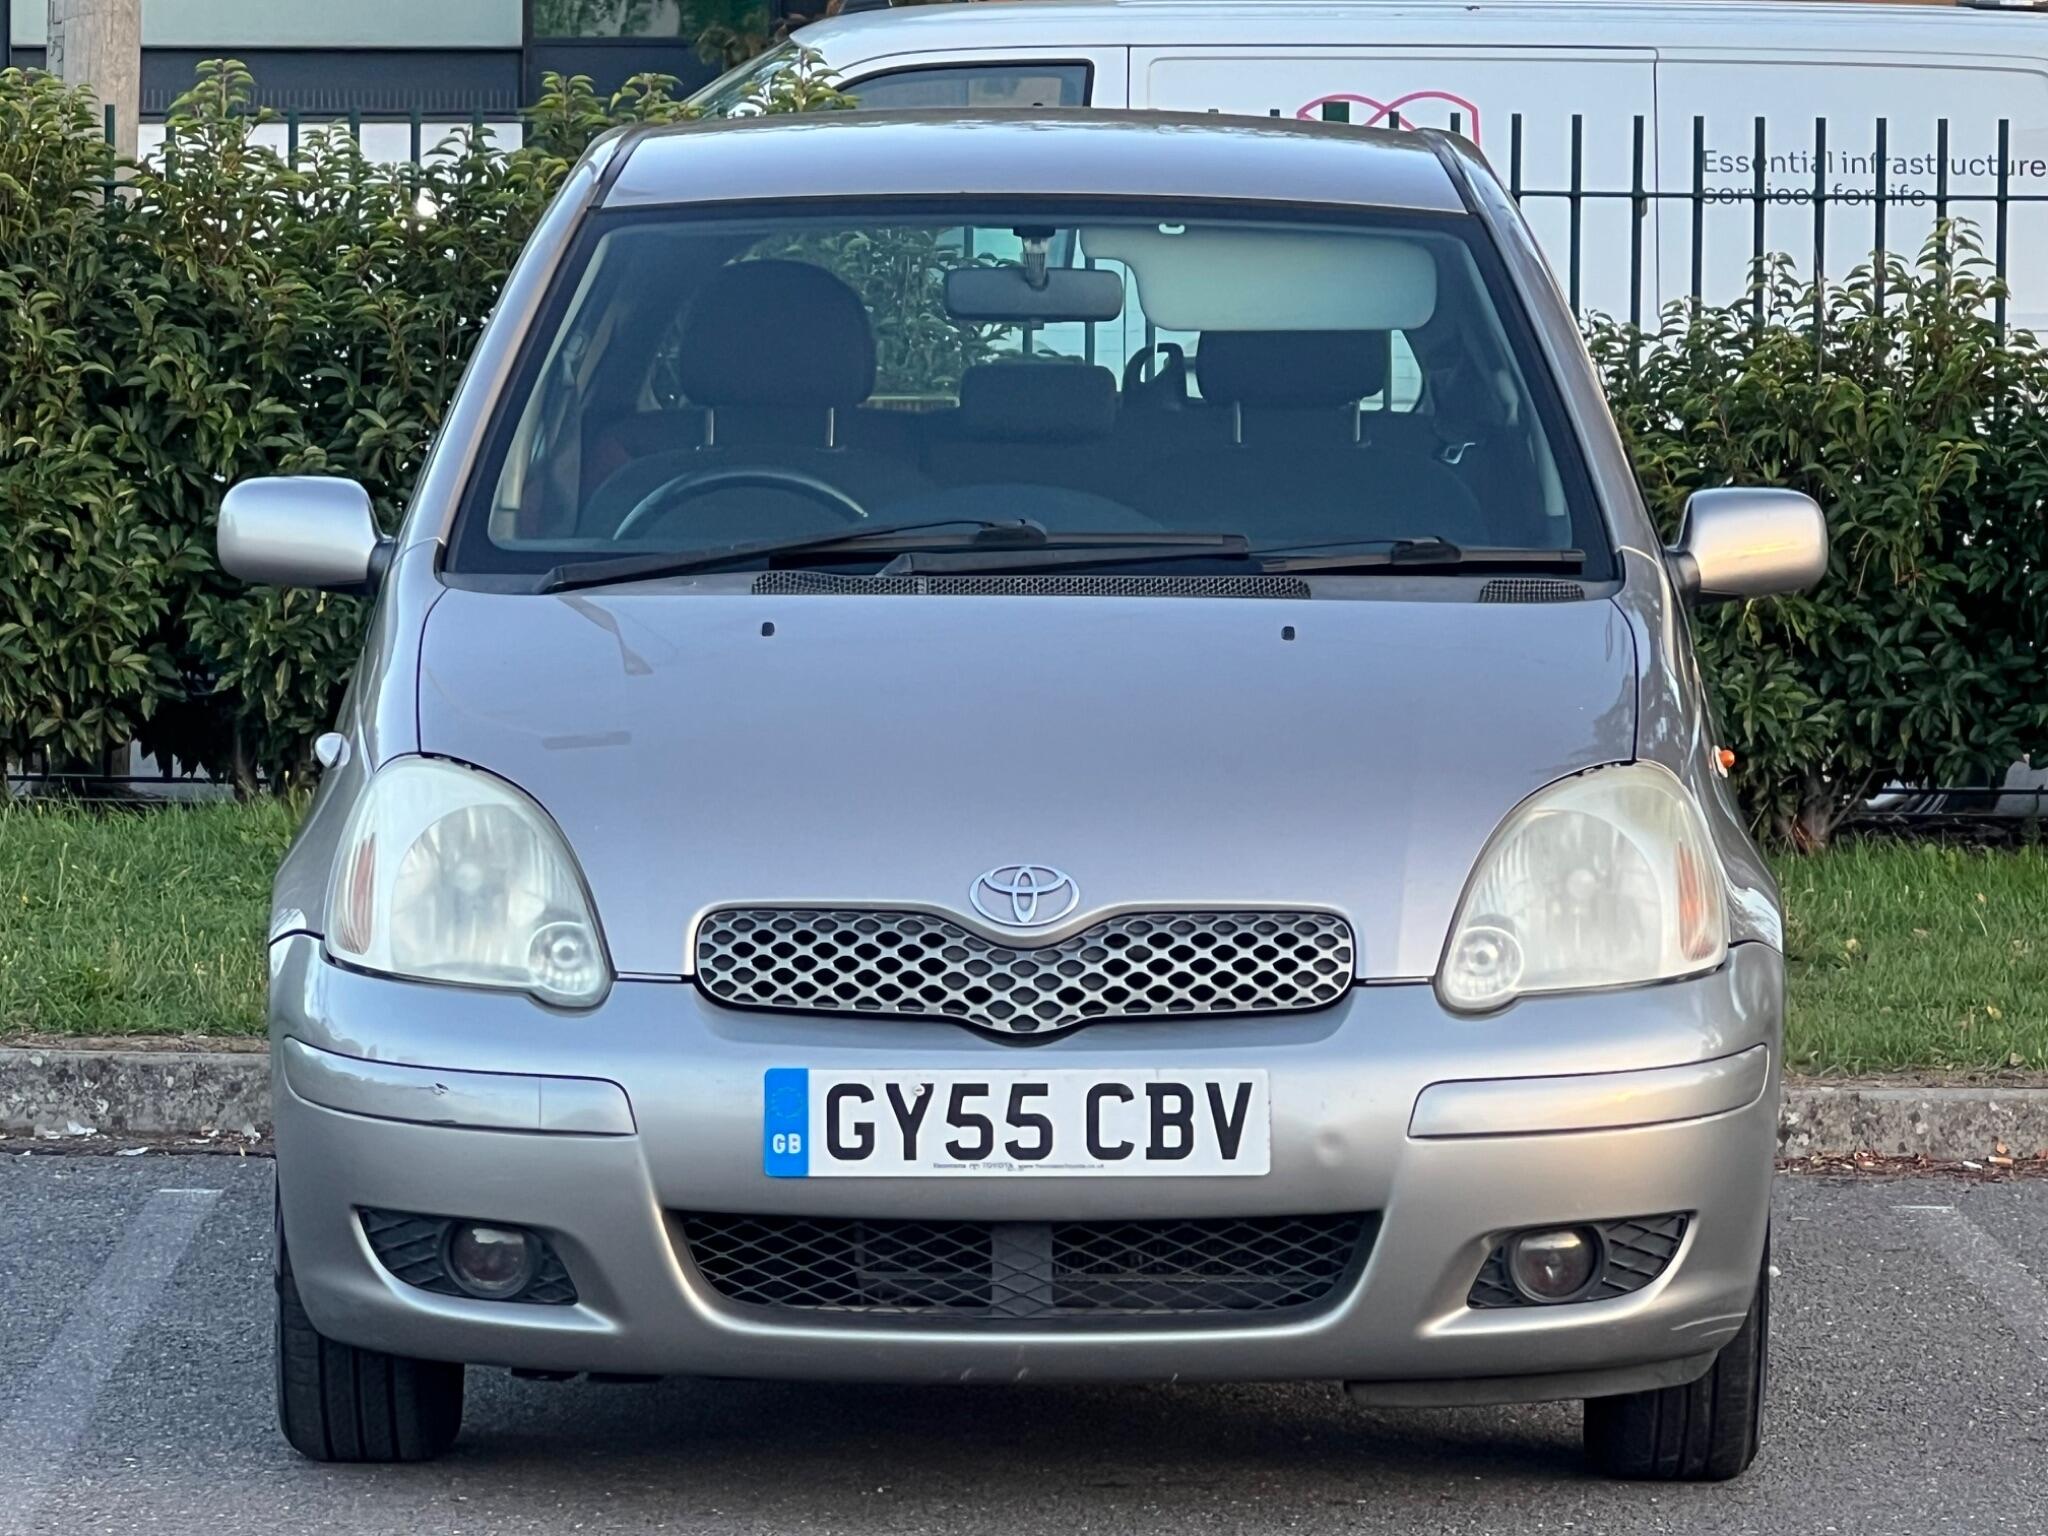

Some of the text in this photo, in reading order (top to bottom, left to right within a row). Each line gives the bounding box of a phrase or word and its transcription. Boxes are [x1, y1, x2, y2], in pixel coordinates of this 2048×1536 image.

[1840, 151, 2047, 177] infastucture
[1702, 183, 1926, 207] serice for ife
[826, 1082, 1253, 1161] GY55 CBV
[773, 1133, 801, 1155] GB
